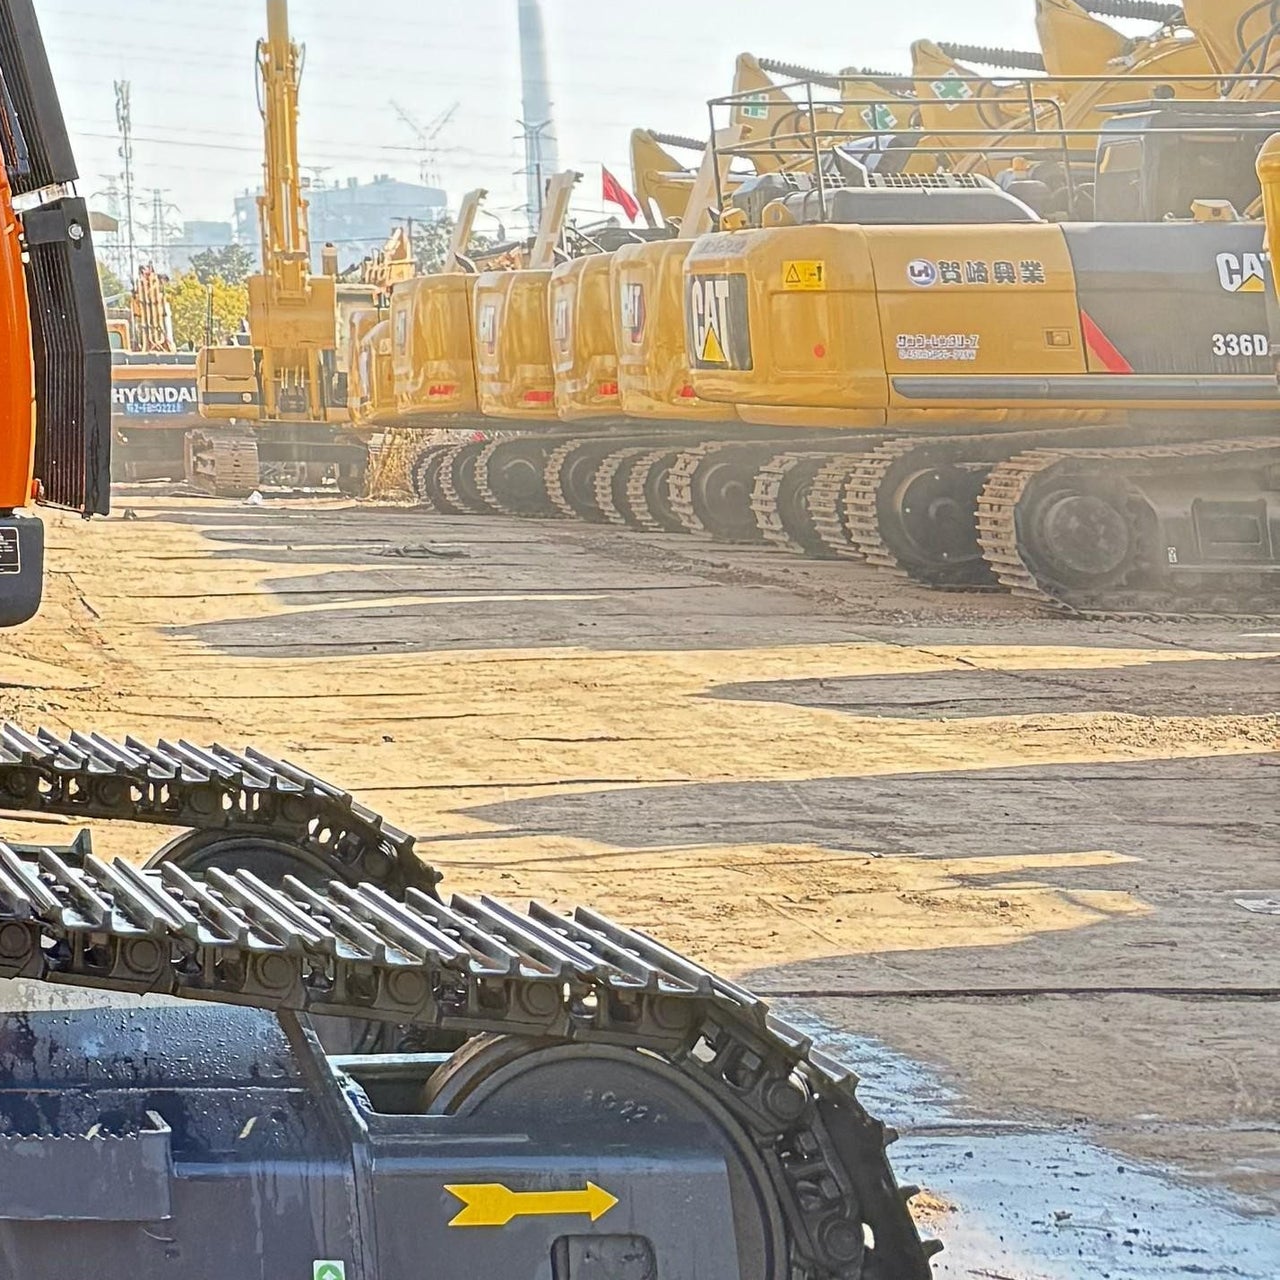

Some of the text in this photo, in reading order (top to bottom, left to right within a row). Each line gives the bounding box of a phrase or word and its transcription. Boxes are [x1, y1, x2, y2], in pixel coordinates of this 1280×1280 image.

[1216, 252, 1266, 293] CA
[692, 279, 730, 366] CAT
[1212, 333, 1268, 357] 336D
[111, 386, 197, 404] HYUNDAI
